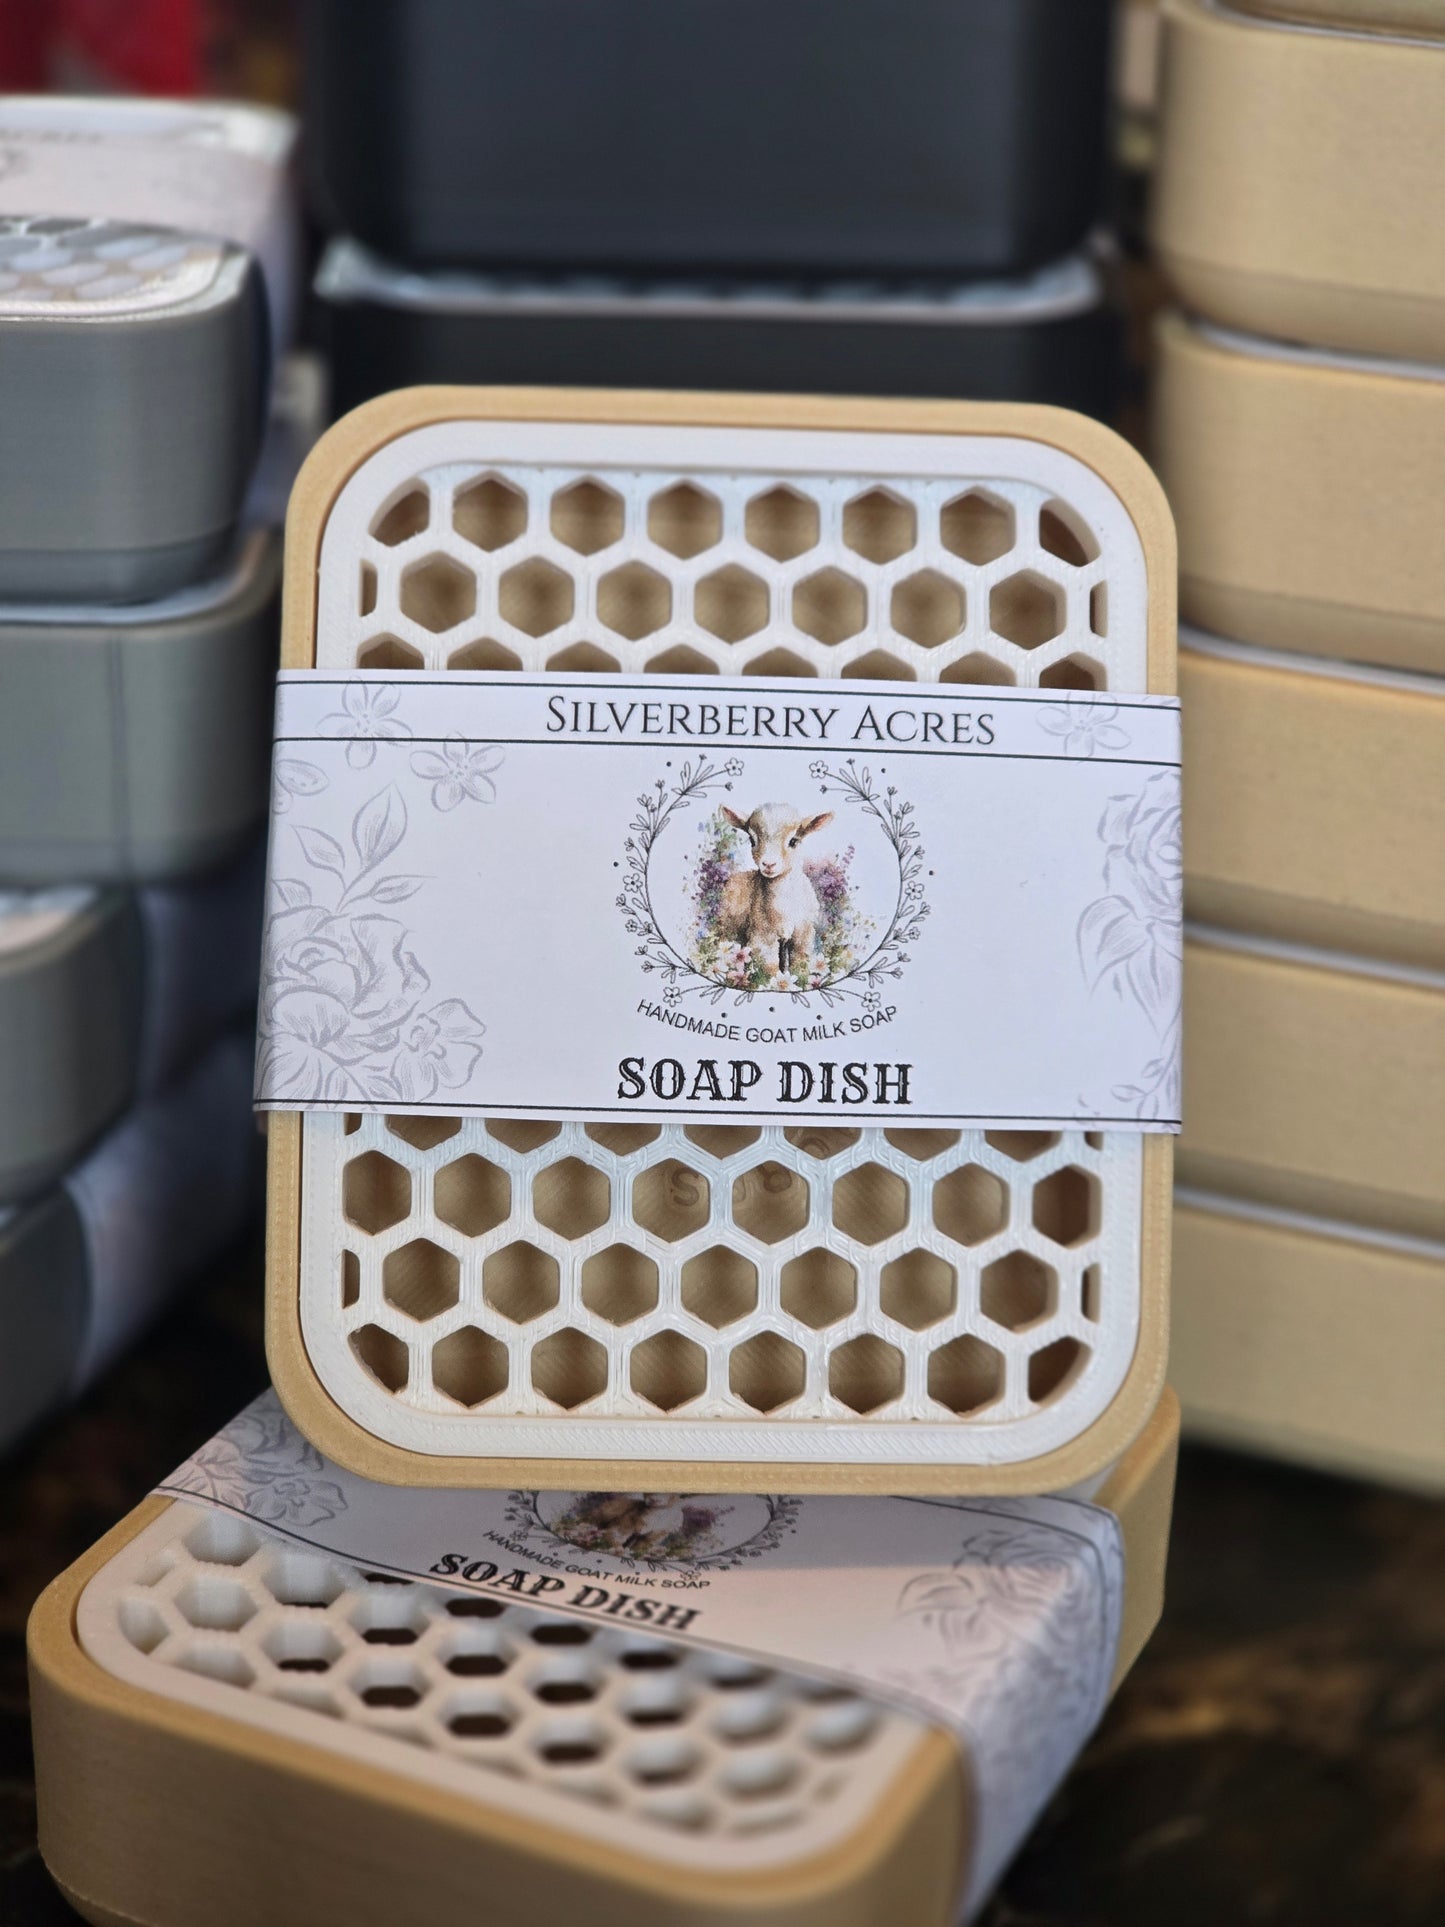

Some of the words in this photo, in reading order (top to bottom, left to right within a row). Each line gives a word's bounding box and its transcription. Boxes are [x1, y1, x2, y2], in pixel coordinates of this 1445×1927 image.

[546, 695, 840, 738] SILVERBERRY
[851, 704, 996, 745] ACRES
[636, 999, 742, 1041] HANDMADE
[745, 1027, 798, 1044] GOAT
[802, 1021, 847, 1042] MILK
[849, 1005, 898, 1034] SOAP
[617, 1056, 763, 1102] SOAP
[776, 1060, 914, 1105] DISH
[482, 1530, 565, 1569] HANDMADE
[565, 1564, 613, 1581] GOAT
[615, 1574, 657, 1588] MILK
[660, 1580, 712, 1590] SOAP
[429, 1553, 566, 1598] SOAP
[566, 1585, 702, 1630] DISH
